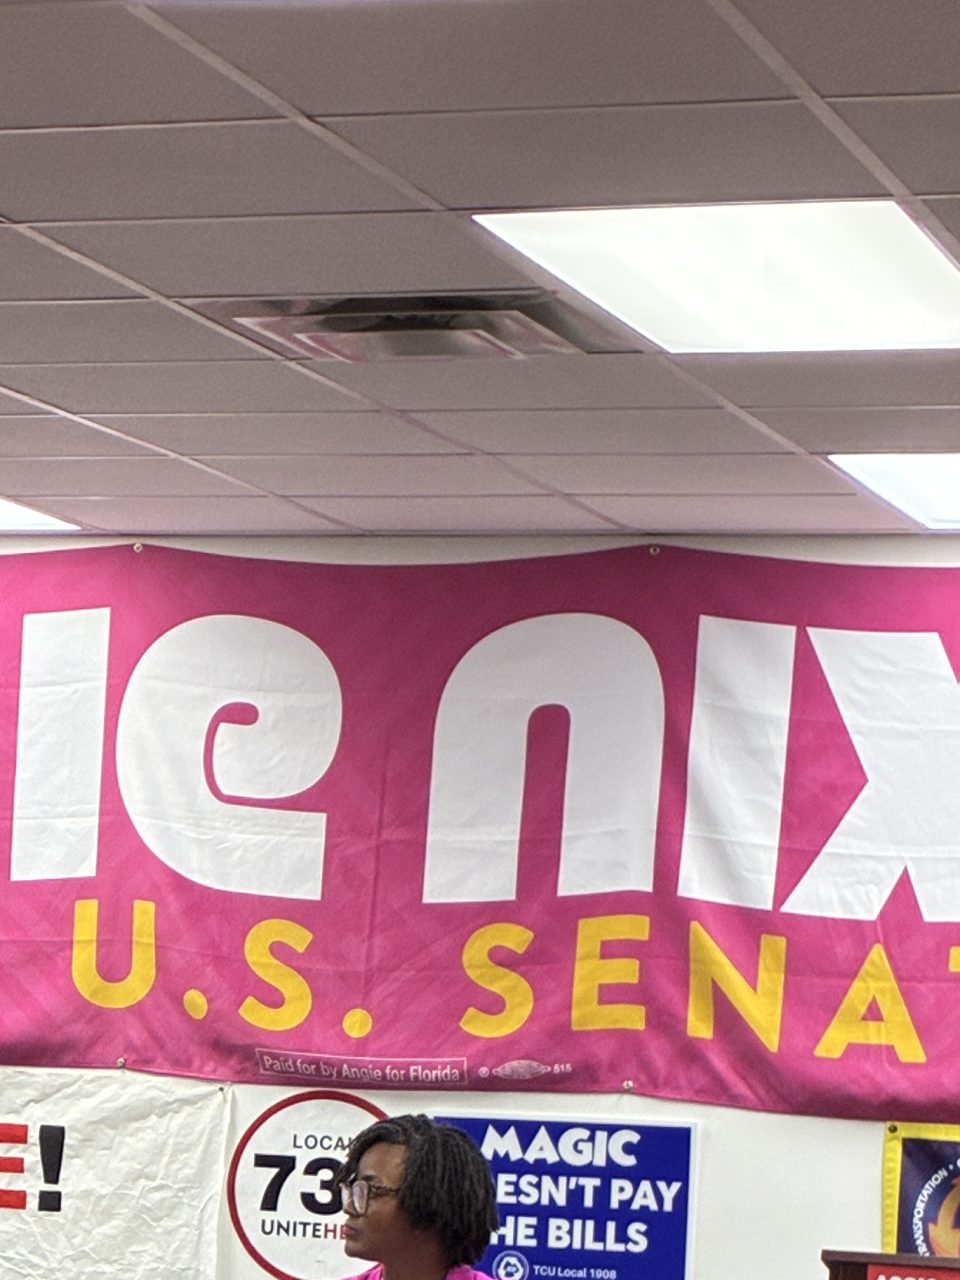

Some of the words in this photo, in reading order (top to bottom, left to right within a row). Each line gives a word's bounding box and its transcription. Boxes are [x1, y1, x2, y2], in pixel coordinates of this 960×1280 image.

[423, 612, 960, 922] NIX
[72, 898, 373, 1039] U.S.
[458, 914, 960, 1065] SENA
[263, 1055, 292, 1072] Paid
[296, 1059, 316, 1075] for
[321, 1062, 337, 1079] by
[342, 1063, 382, 1081] Angie
[385, 1065, 405, 1081] for
[409, 1065, 460, 1083] Florida
[292, 1134, 353, 1151] LOCA
[480, 1124, 641, 1167] MAGIC
[253, 1153, 344, 1216] 73
[496, 1173, 601, 1208] ESN'T
[610, 1178, 682, 1212] PAY
[490, 1216, 537, 1247] HE
[547, 1218, 648, 1253] BILLS
[533, 1265, 556, 1277] TCU
[558, 1266, 587, 1278] Local
[590, 1268, 617, 1280] 1908
